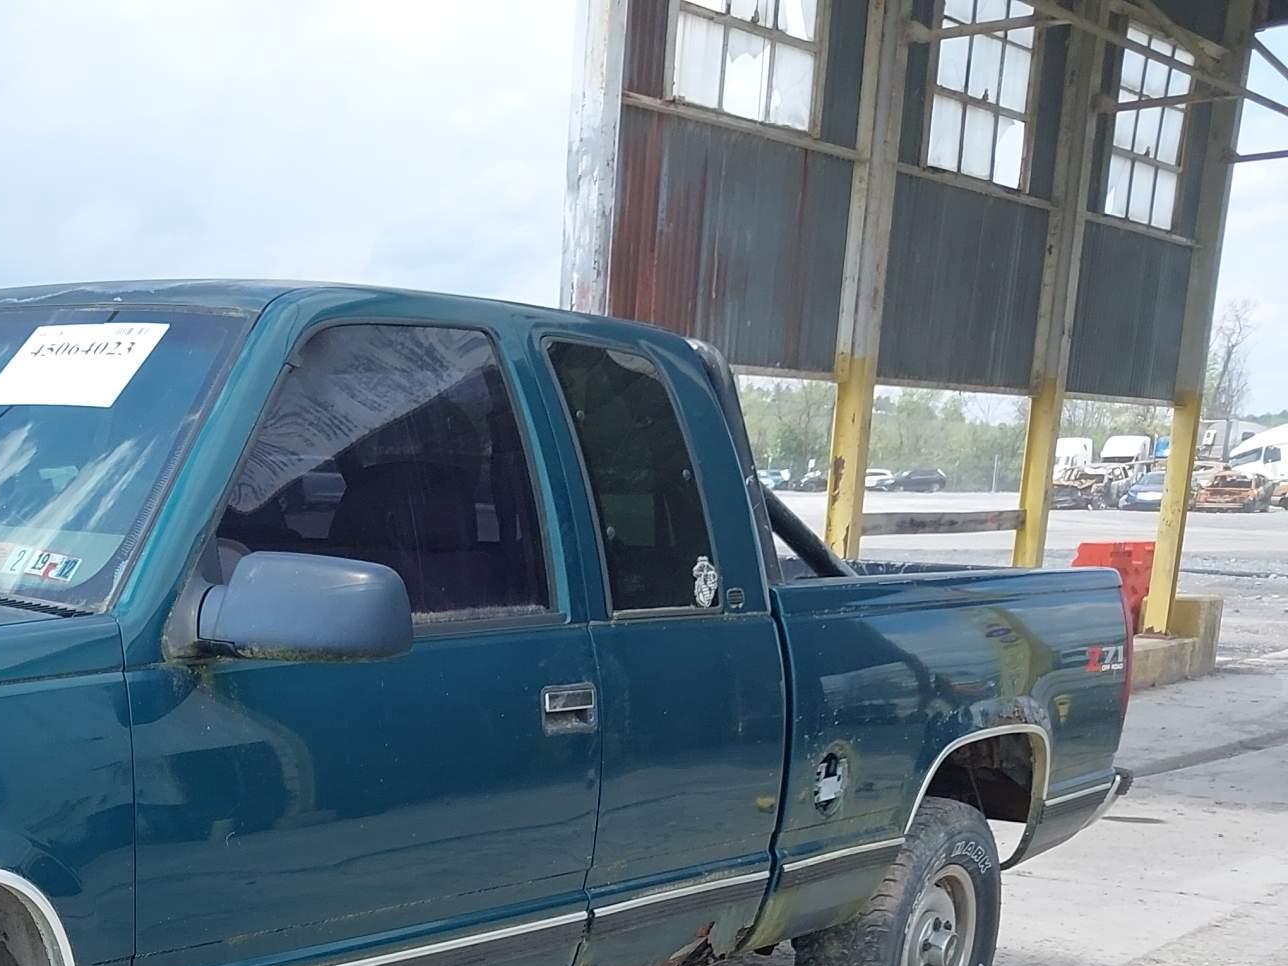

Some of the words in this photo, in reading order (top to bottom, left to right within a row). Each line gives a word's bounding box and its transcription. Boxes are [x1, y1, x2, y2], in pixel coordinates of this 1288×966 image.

[30, 341, 136, 357] 45064023
[10, 549, 27, 571] 2
[31, 553, 51, 571] 19
[1086, 645, 1124, 673] Z71
[950, 841, 992, 874] MARK
